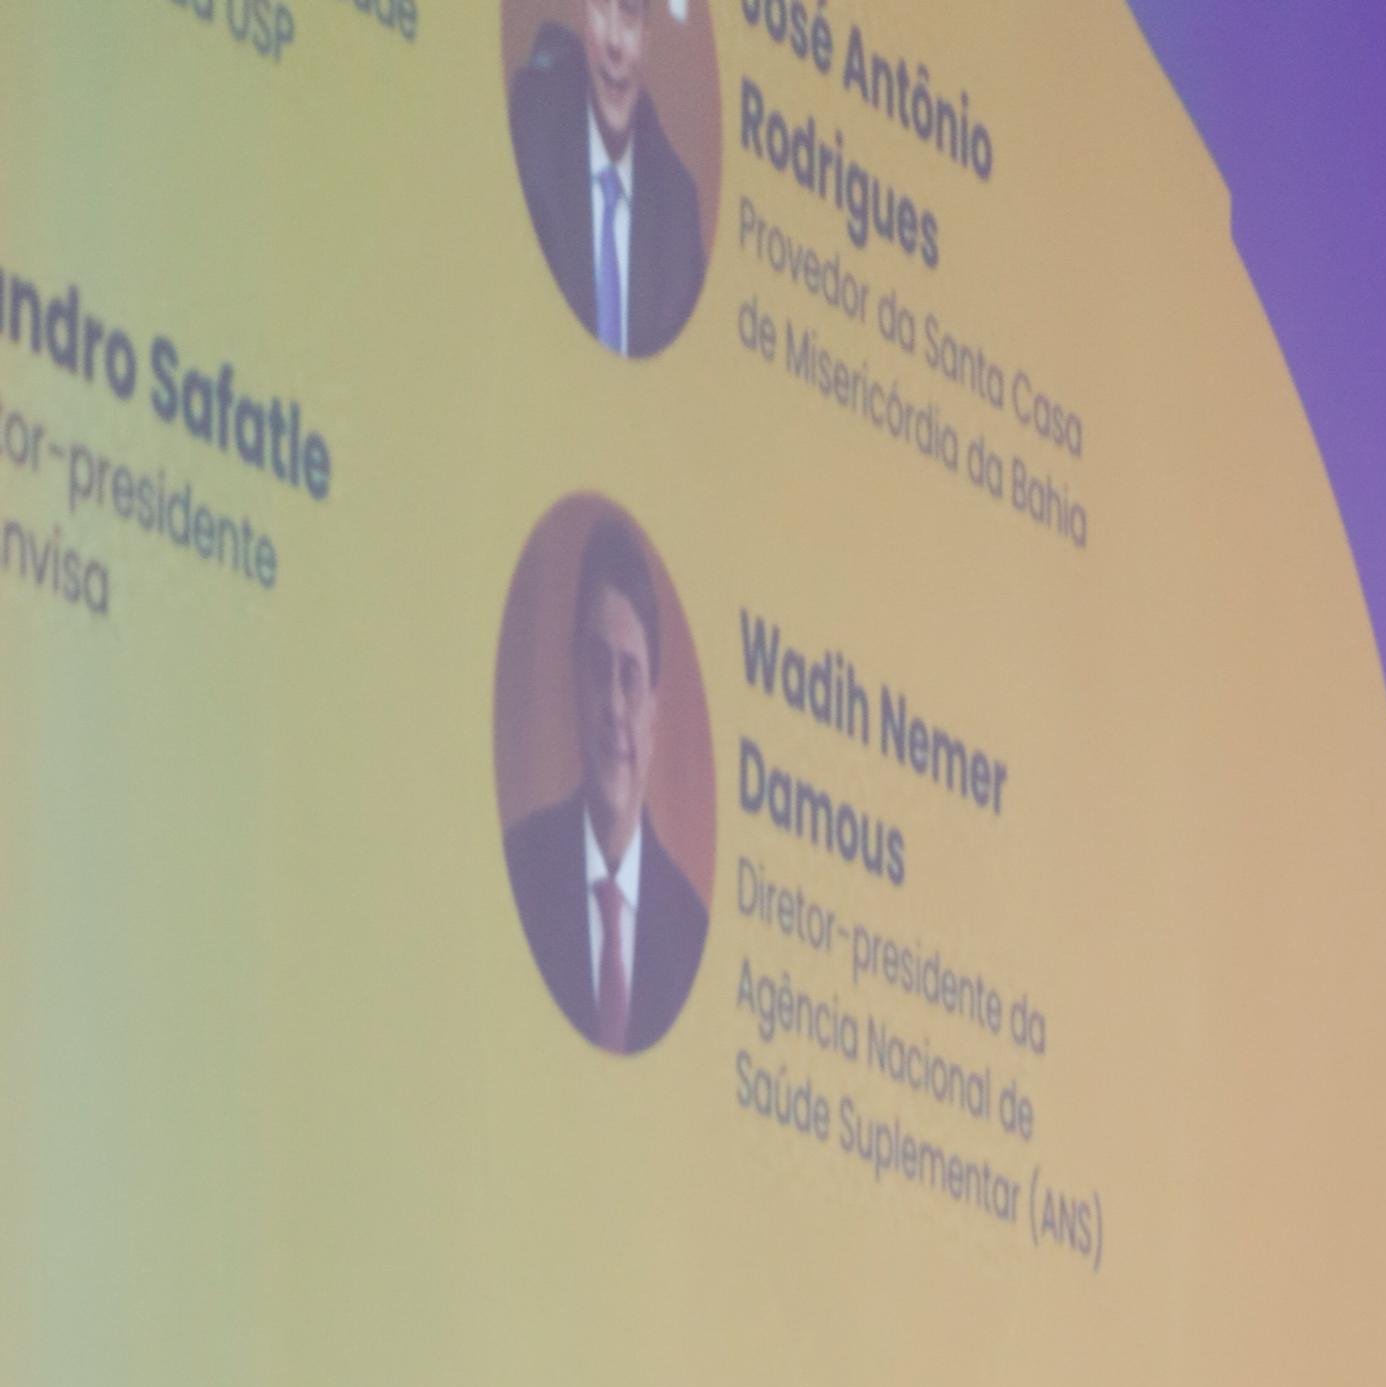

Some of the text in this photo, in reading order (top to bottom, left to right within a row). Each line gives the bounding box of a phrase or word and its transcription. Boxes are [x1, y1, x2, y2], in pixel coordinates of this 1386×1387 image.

[740, 74, 940, 270] Rodrigues
[842, 24, 993, 182] Antônio
[0, 262, 332, 501] ndro Safatle
[738, 299, 1088, 548] de Misericórdia da Bahia
[739, 195, 1083, 458] Provedor da Santa Casa
[0, 405, 278, 591] or-presidente
[739, 606, 1008, 816] Wadih Nemer
[739, 735, 907, 887] Damous
[737, 956, 1035, 1143] Agência Nacional de
[738, 855, 1047, 1057] Diretor-presidente da
[735, 1048, 1102, 1274] Saúde Suplementar (ANS)
